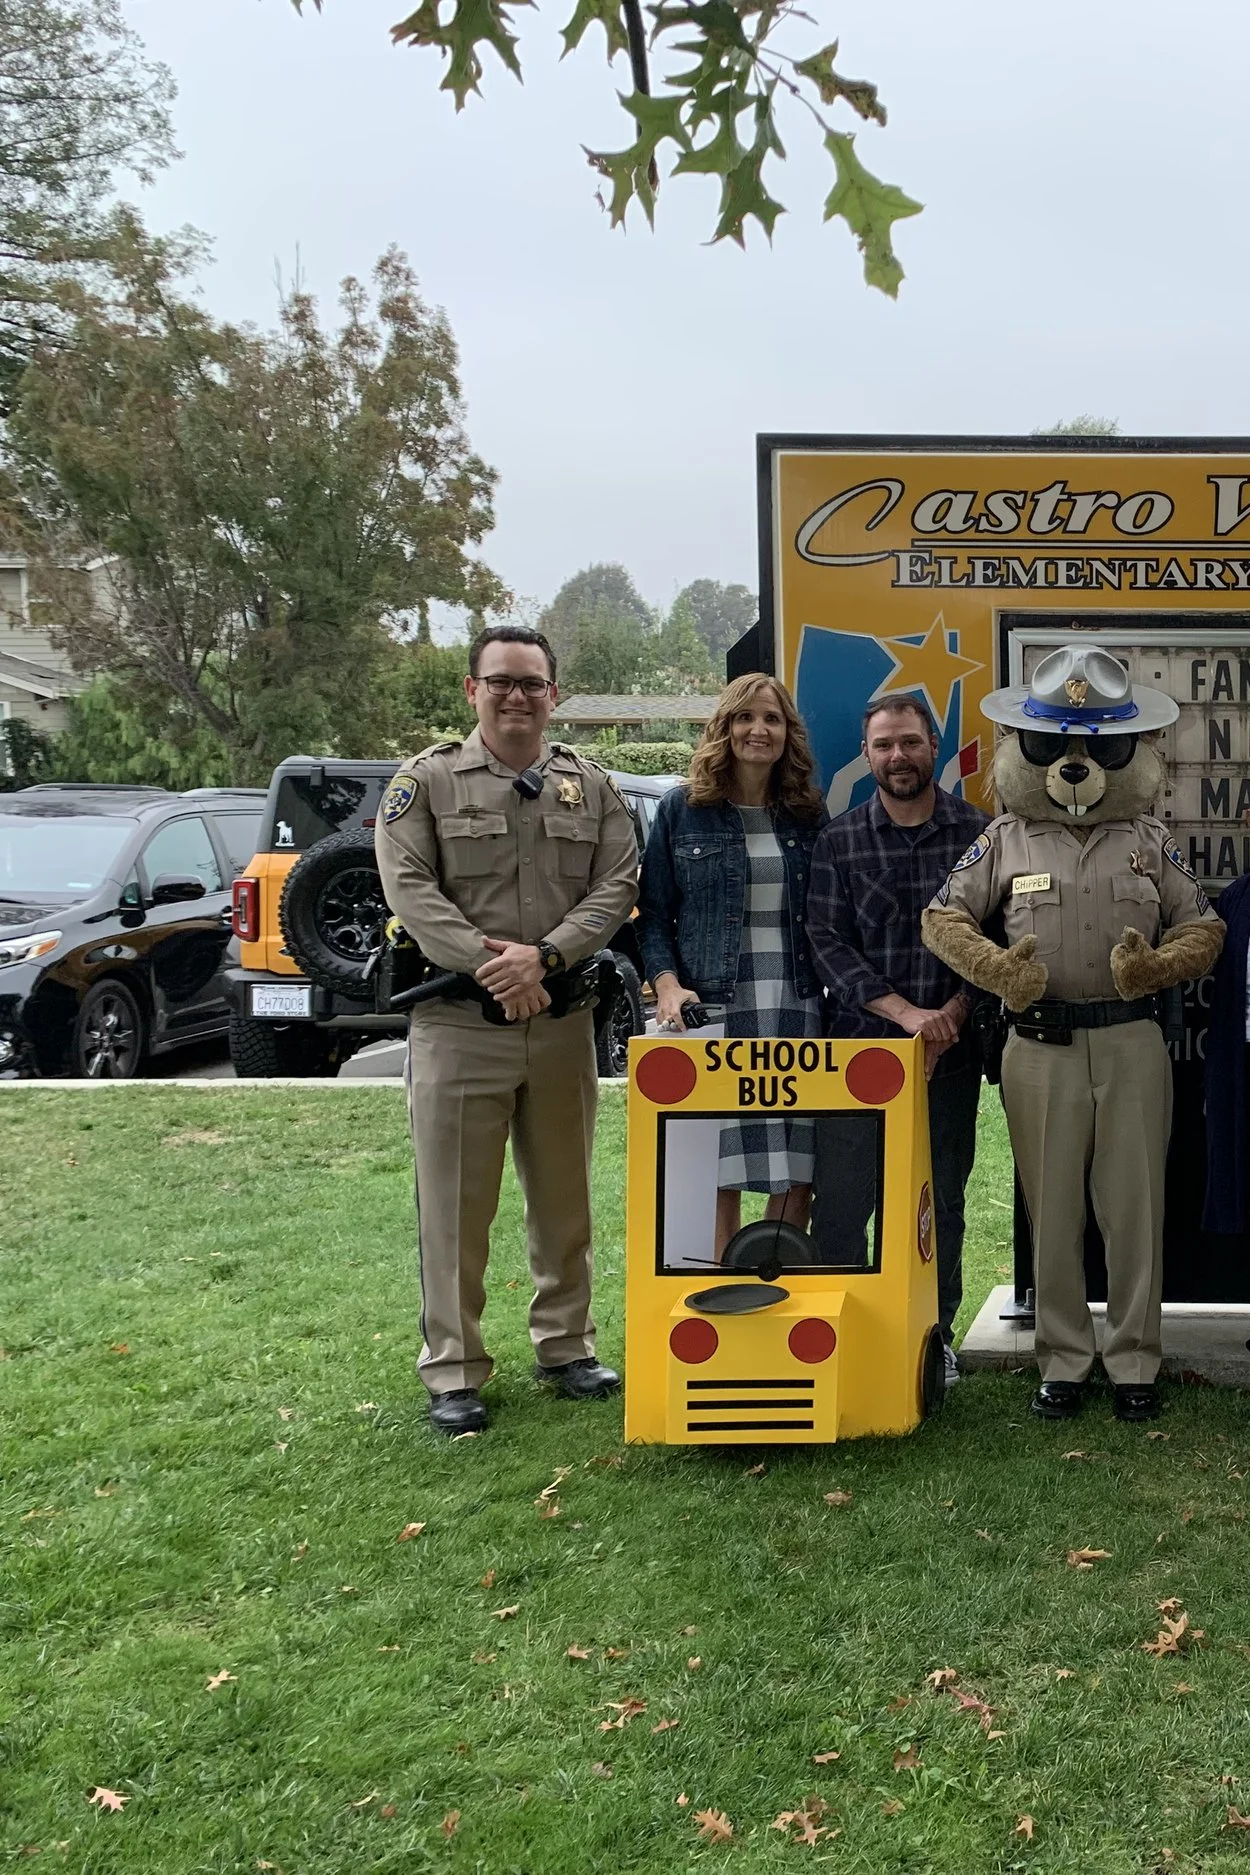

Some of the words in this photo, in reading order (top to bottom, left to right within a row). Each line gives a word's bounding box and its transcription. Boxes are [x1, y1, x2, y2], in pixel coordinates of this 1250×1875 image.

[795, 478, 1174, 566] Castro
[705, 1040, 839, 1072] SCHOOL
[738, 1076, 798, 1107] BUS
